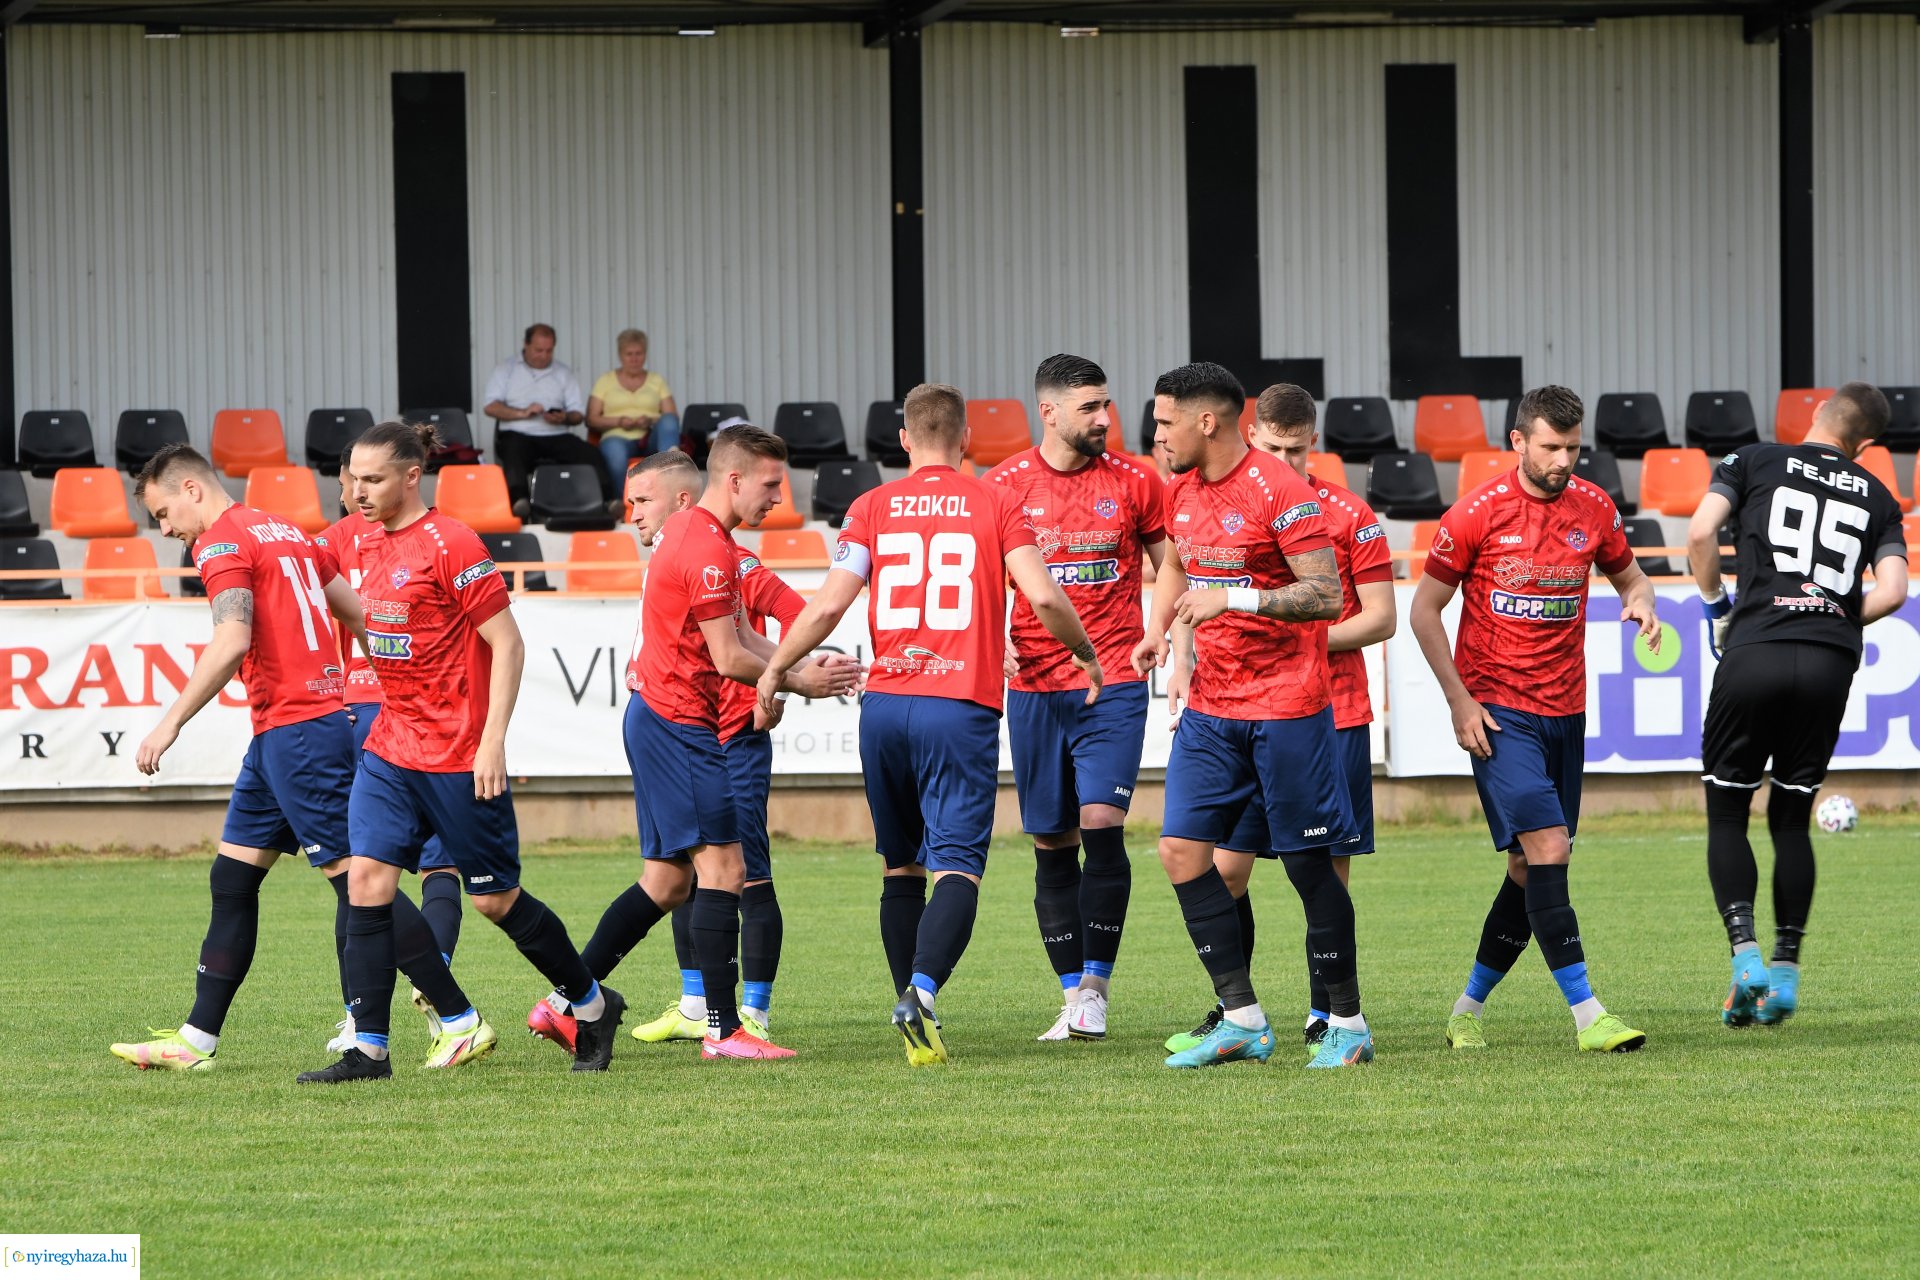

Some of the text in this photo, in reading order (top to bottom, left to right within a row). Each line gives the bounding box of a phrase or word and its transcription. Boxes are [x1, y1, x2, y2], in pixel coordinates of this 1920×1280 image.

[1787, 457, 1869, 497] FEJÉR
[889, 494, 971, 518] SZOKOL
[1060, 530, 1121, 546] REVESZ
[1498, 535, 1523, 545] JAKO
[1768, 485, 1871, 596] 95
[1191, 545, 1246, 562] REVESZ
[1533, 566, 1587, 580] REVESZ
[876, 532, 977, 631] 28
[277, 556, 333, 651] 14
[1774, 596, 1825, 606] LERTON
[1114, 786, 1131, 797] JAKO
[1303, 826, 1328, 837] JAKO
[1088, 921, 1119, 932] JAKO
[1043, 933, 1073, 943] JAKO
